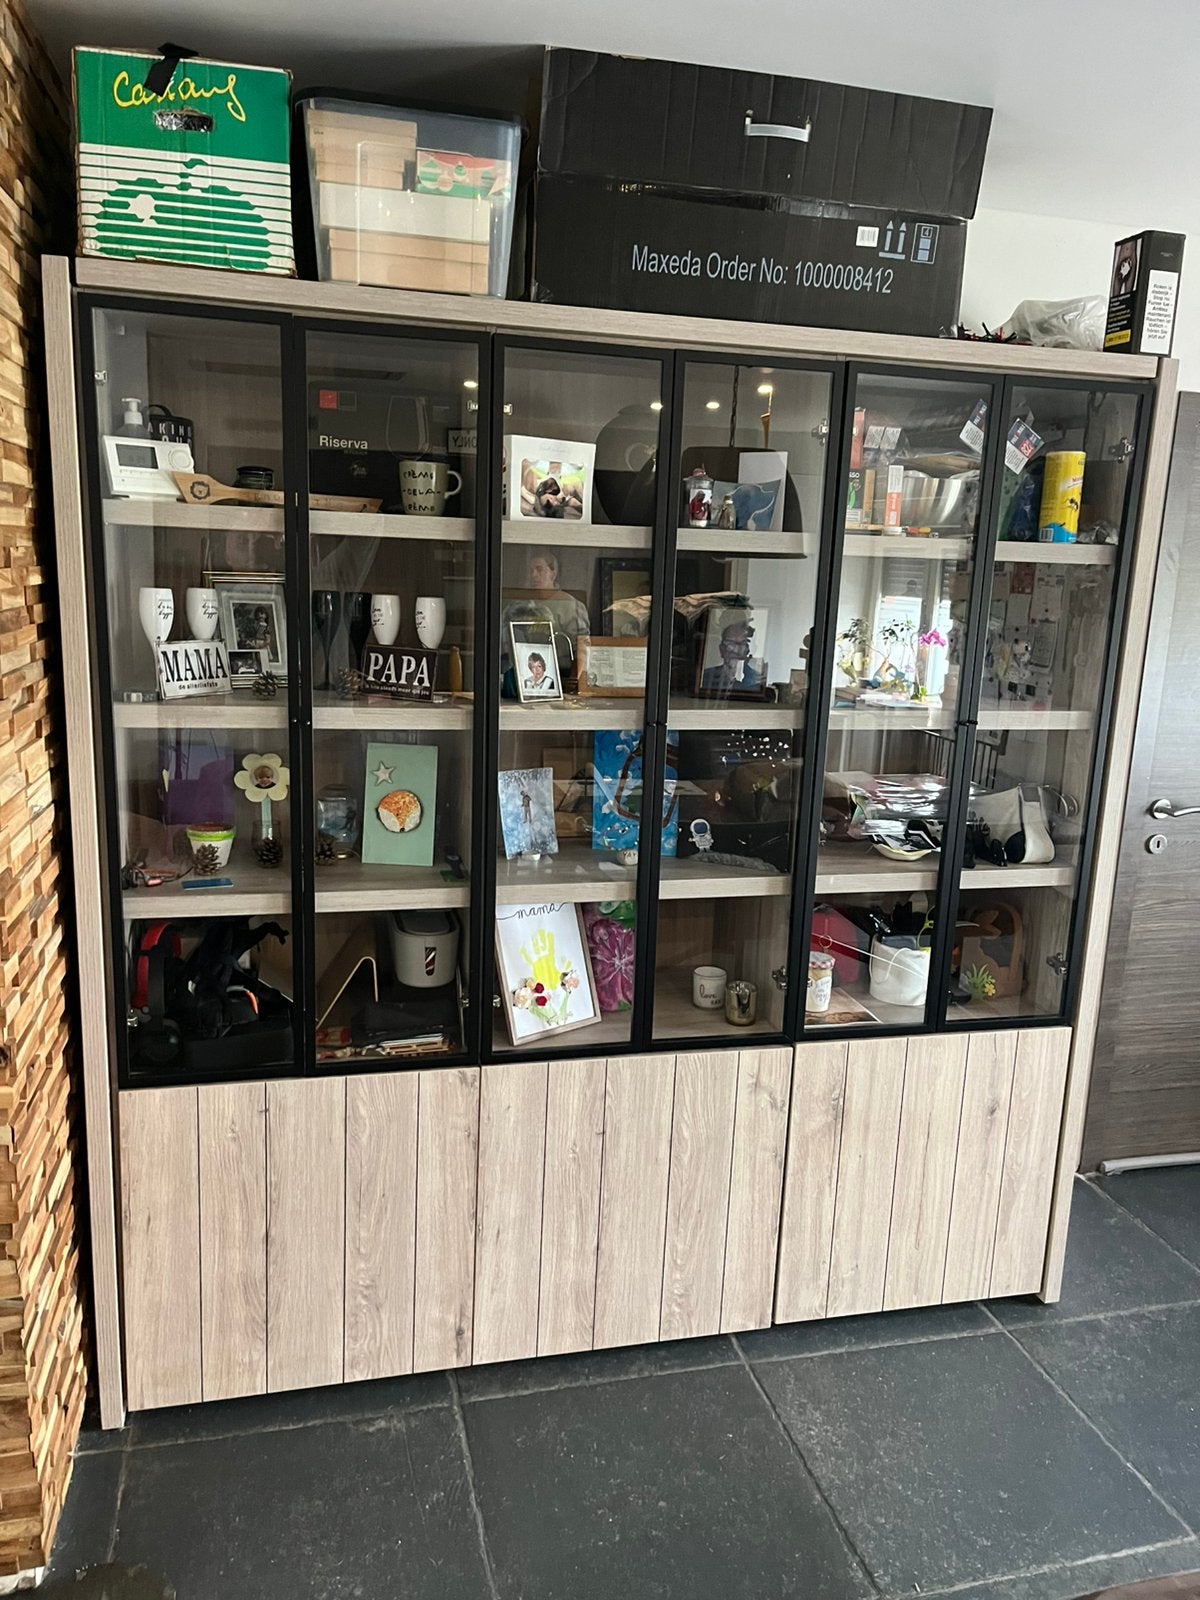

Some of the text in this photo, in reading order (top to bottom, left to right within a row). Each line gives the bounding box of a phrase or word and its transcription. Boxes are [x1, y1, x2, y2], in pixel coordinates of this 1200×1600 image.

[632, 244, 894, 294] Maxeda Order No: 1000008412
[319, 435, 369, 450] Riserva
[160, 647, 228, 683] MAMA
[366, 652, 431, 687] PAPA
[502, 901, 569, 919] mama
